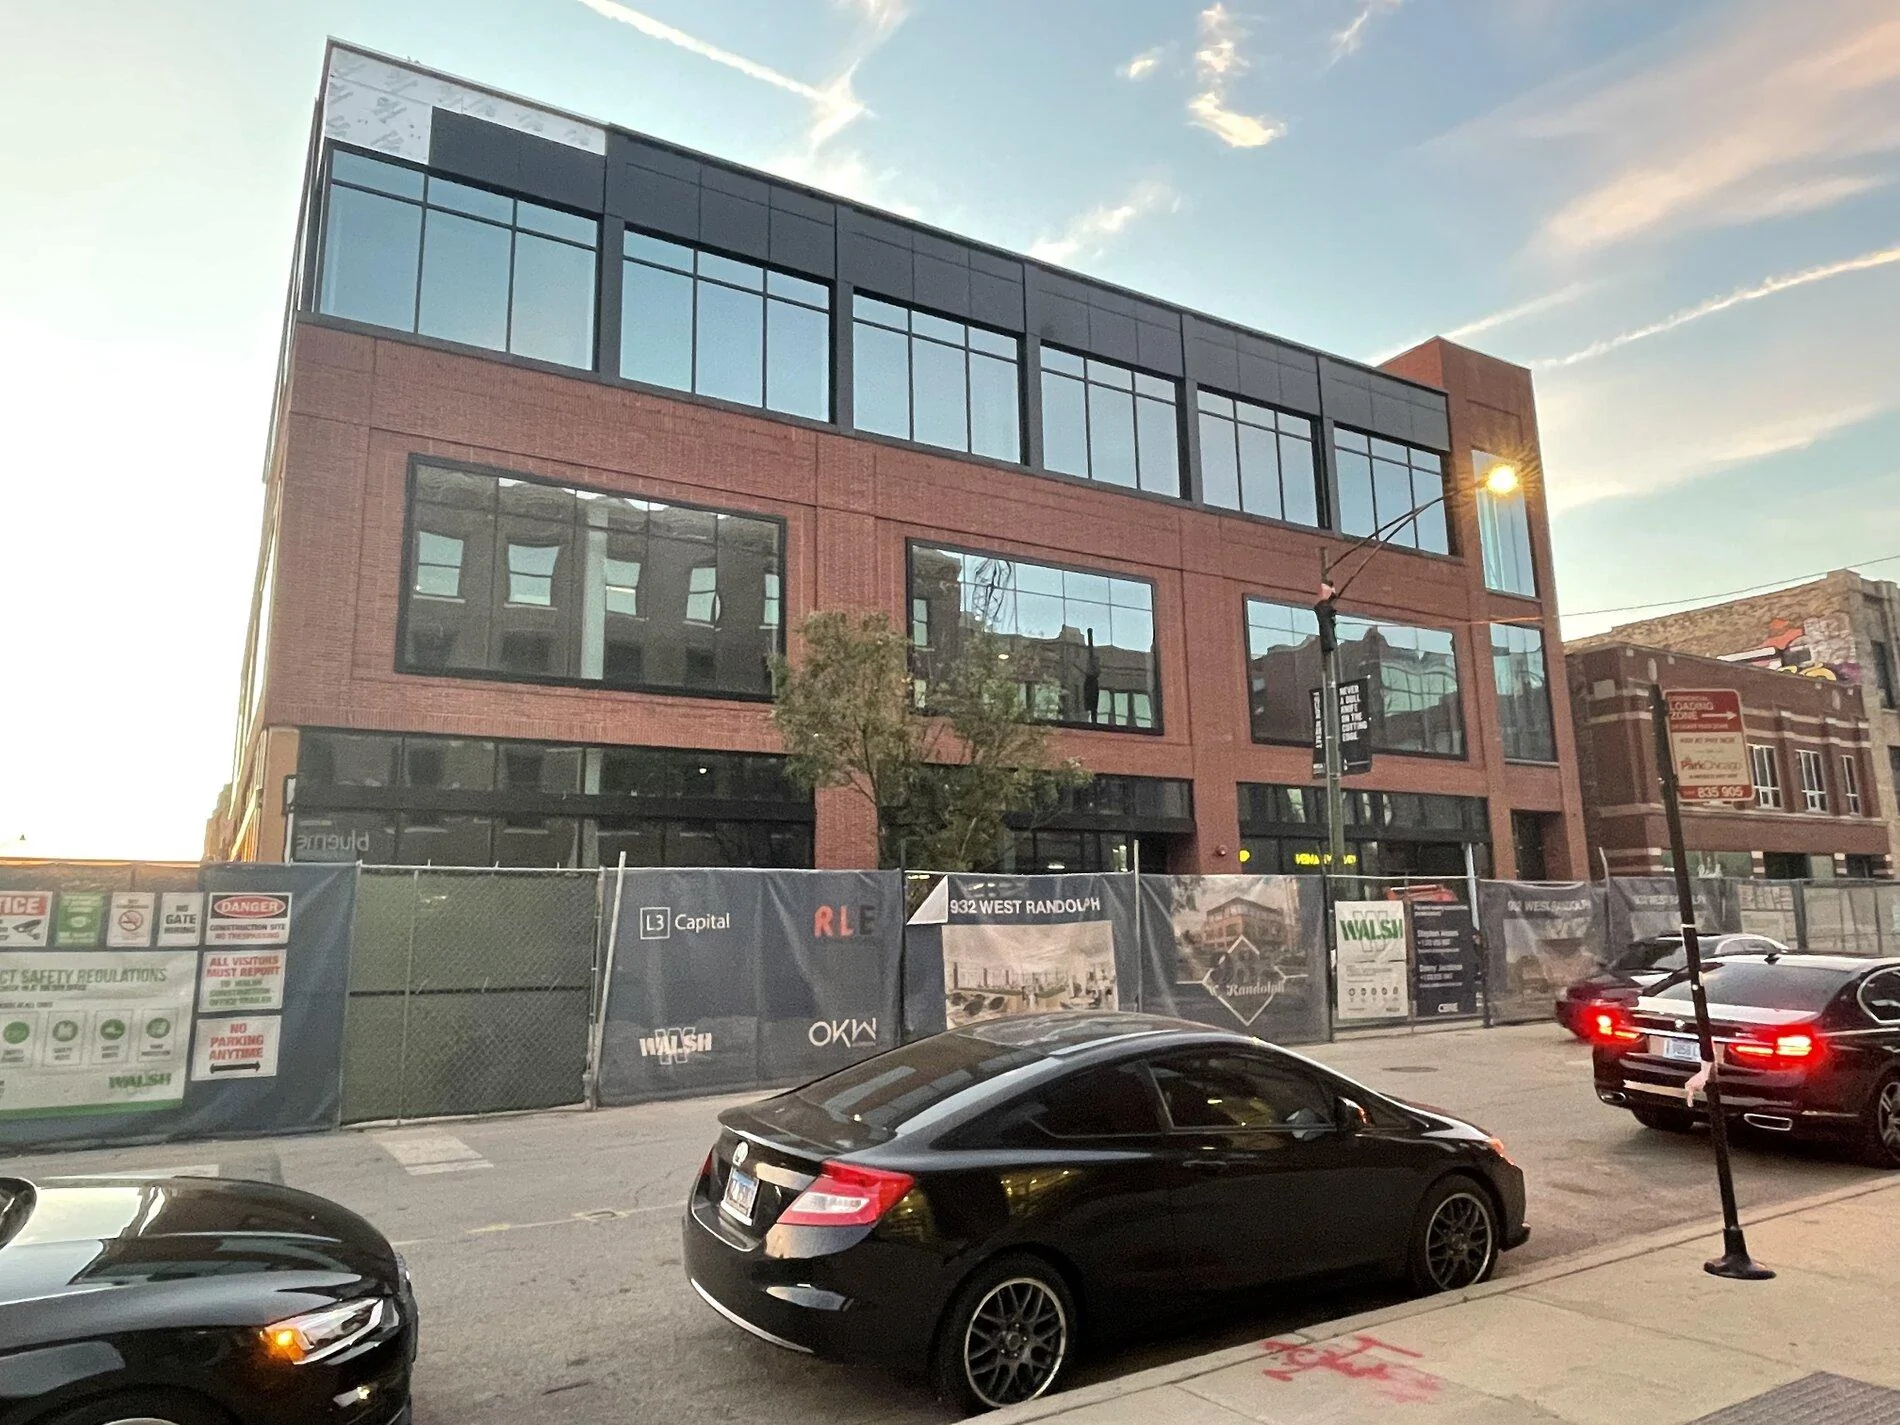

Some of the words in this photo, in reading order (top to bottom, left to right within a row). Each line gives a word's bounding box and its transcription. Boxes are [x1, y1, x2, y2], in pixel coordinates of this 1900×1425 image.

[1669, 701, 1714, 711] LOADING
[1669, 711, 1699, 720] ZONE
[1698, 787, 1719, 798] 835
[221, 901, 278, 913] DANGER
[950, 899, 977, 914] 932
[978, 899, 1022, 914] WEST
[1026, 896, 1101, 914] RANDOLPH
[165, 914, 196, 924] GATE
[675, 912, 730, 933] Capital
[1340, 918, 1403, 941] WALSH
[209, 957, 229, 967] ALL
[232, 955, 279, 966] VISITORS
[21, 969, 74, 984] SAFETY
[77, 967, 167, 984] REGULATIONS
[206, 968, 237, 977] MUST
[240, 966, 281, 977] REPORT
[230, 1023, 247, 1033] NO
[808, 1017, 876, 1048] OKW
[210, 1035, 264, 1047] PARKING
[209, 1047, 264, 1060] ANYTIME
